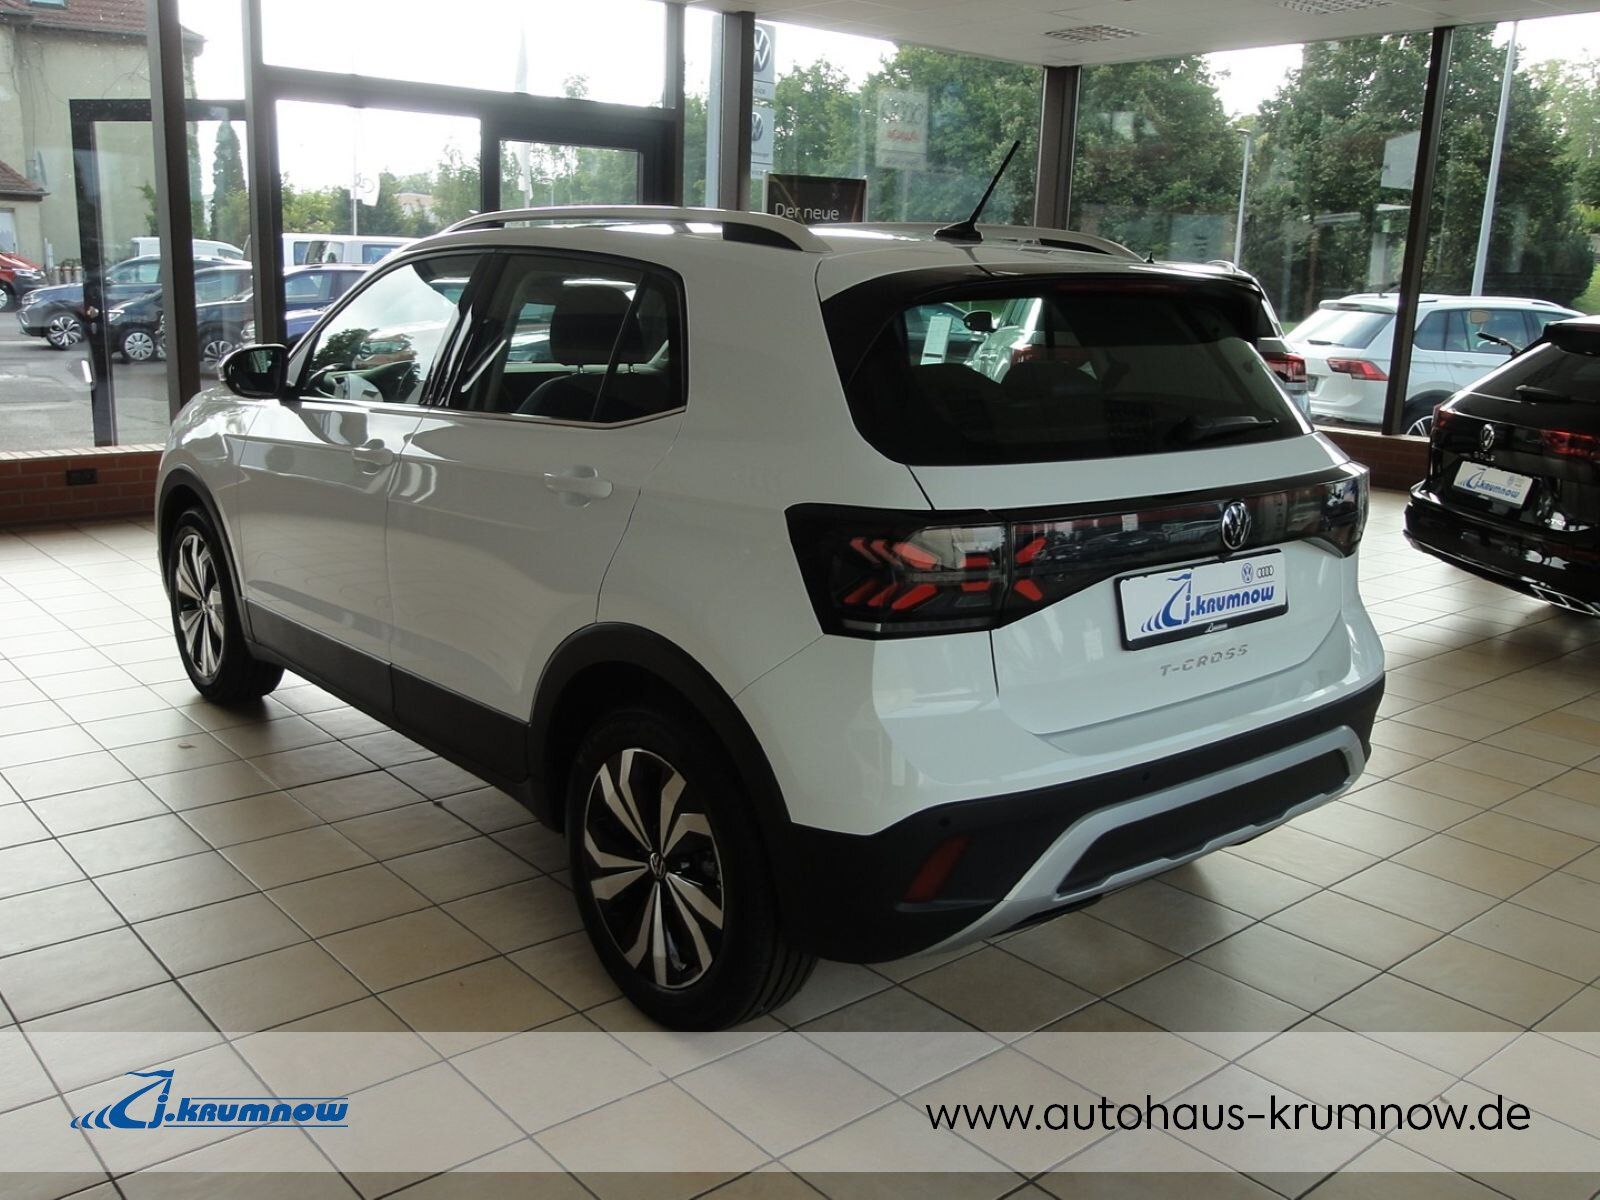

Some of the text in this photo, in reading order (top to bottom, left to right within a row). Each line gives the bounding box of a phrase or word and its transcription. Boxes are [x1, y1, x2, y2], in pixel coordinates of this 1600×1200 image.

[775, 203, 839, 221] Der neue
[1160, 643, 1248, 677] T-CROSS
